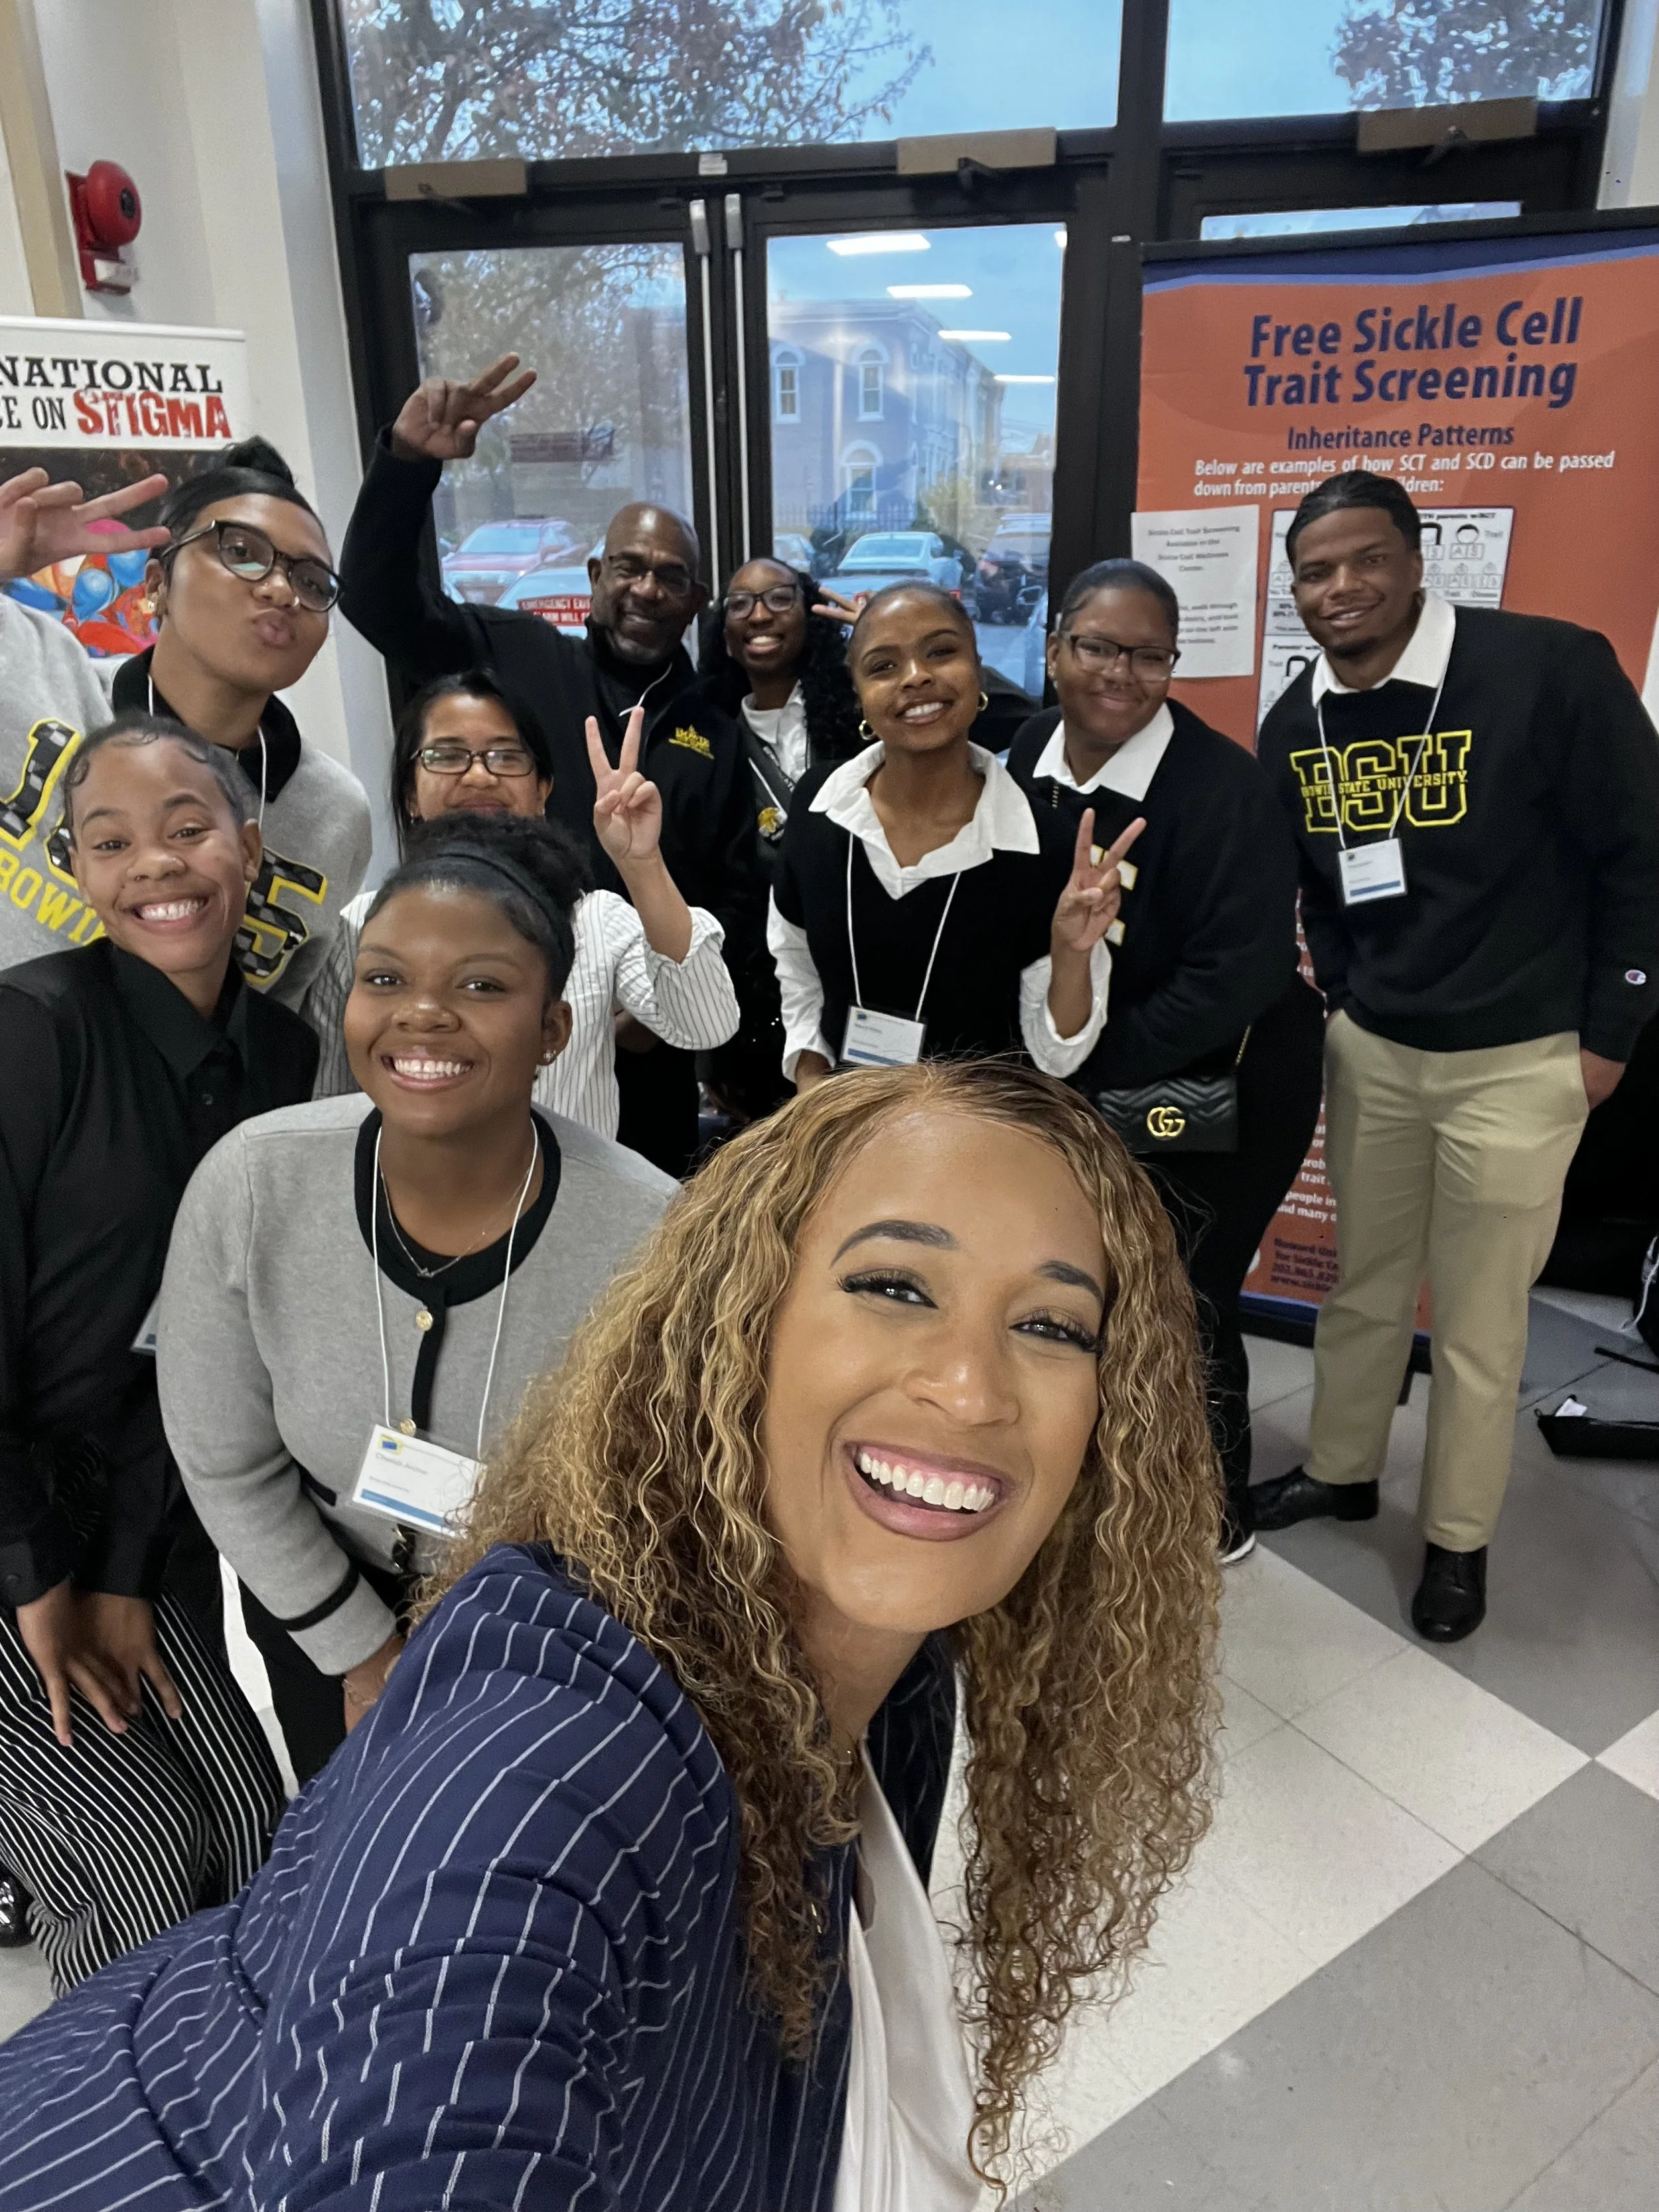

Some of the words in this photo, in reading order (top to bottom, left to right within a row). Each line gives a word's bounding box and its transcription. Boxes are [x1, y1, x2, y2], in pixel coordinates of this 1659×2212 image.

[1250, 314, 1342, 358] Free
[1352, 303, 1482, 353] Sickle
[1496, 296, 1583, 346] Cell
[1244, 360, 1342, 407] Trait
[1352, 352, 1578, 409] Screening
[33, 396, 66, 430] ON
[73, 388, 232, 438] STIGMA
[1287, 425, 1411, 450] Inheritance
[1417, 423, 1514, 446] Patterns
[1195, 459, 1238, 476] Below
[1242, 461, 1265, 475] are
[1269, 456, 1336, 477] examples
[1342, 455, 1359, 472] of
[1399, 453, 1427, 471] SCT
[1431, 453, 1461, 471] and
[1465, 452, 1494, 470] SCD
[1500, 455, 1528, 470] can
[1534, 451, 1553, 469] be
[1559, 450, 1615, 473] passed
[1194, 480, 1231, 496] down
[1234, 479, 1267, 496] from
[1289, 729, 1472, 833] BSU
[1297, 1207, 1327, 1222] many
